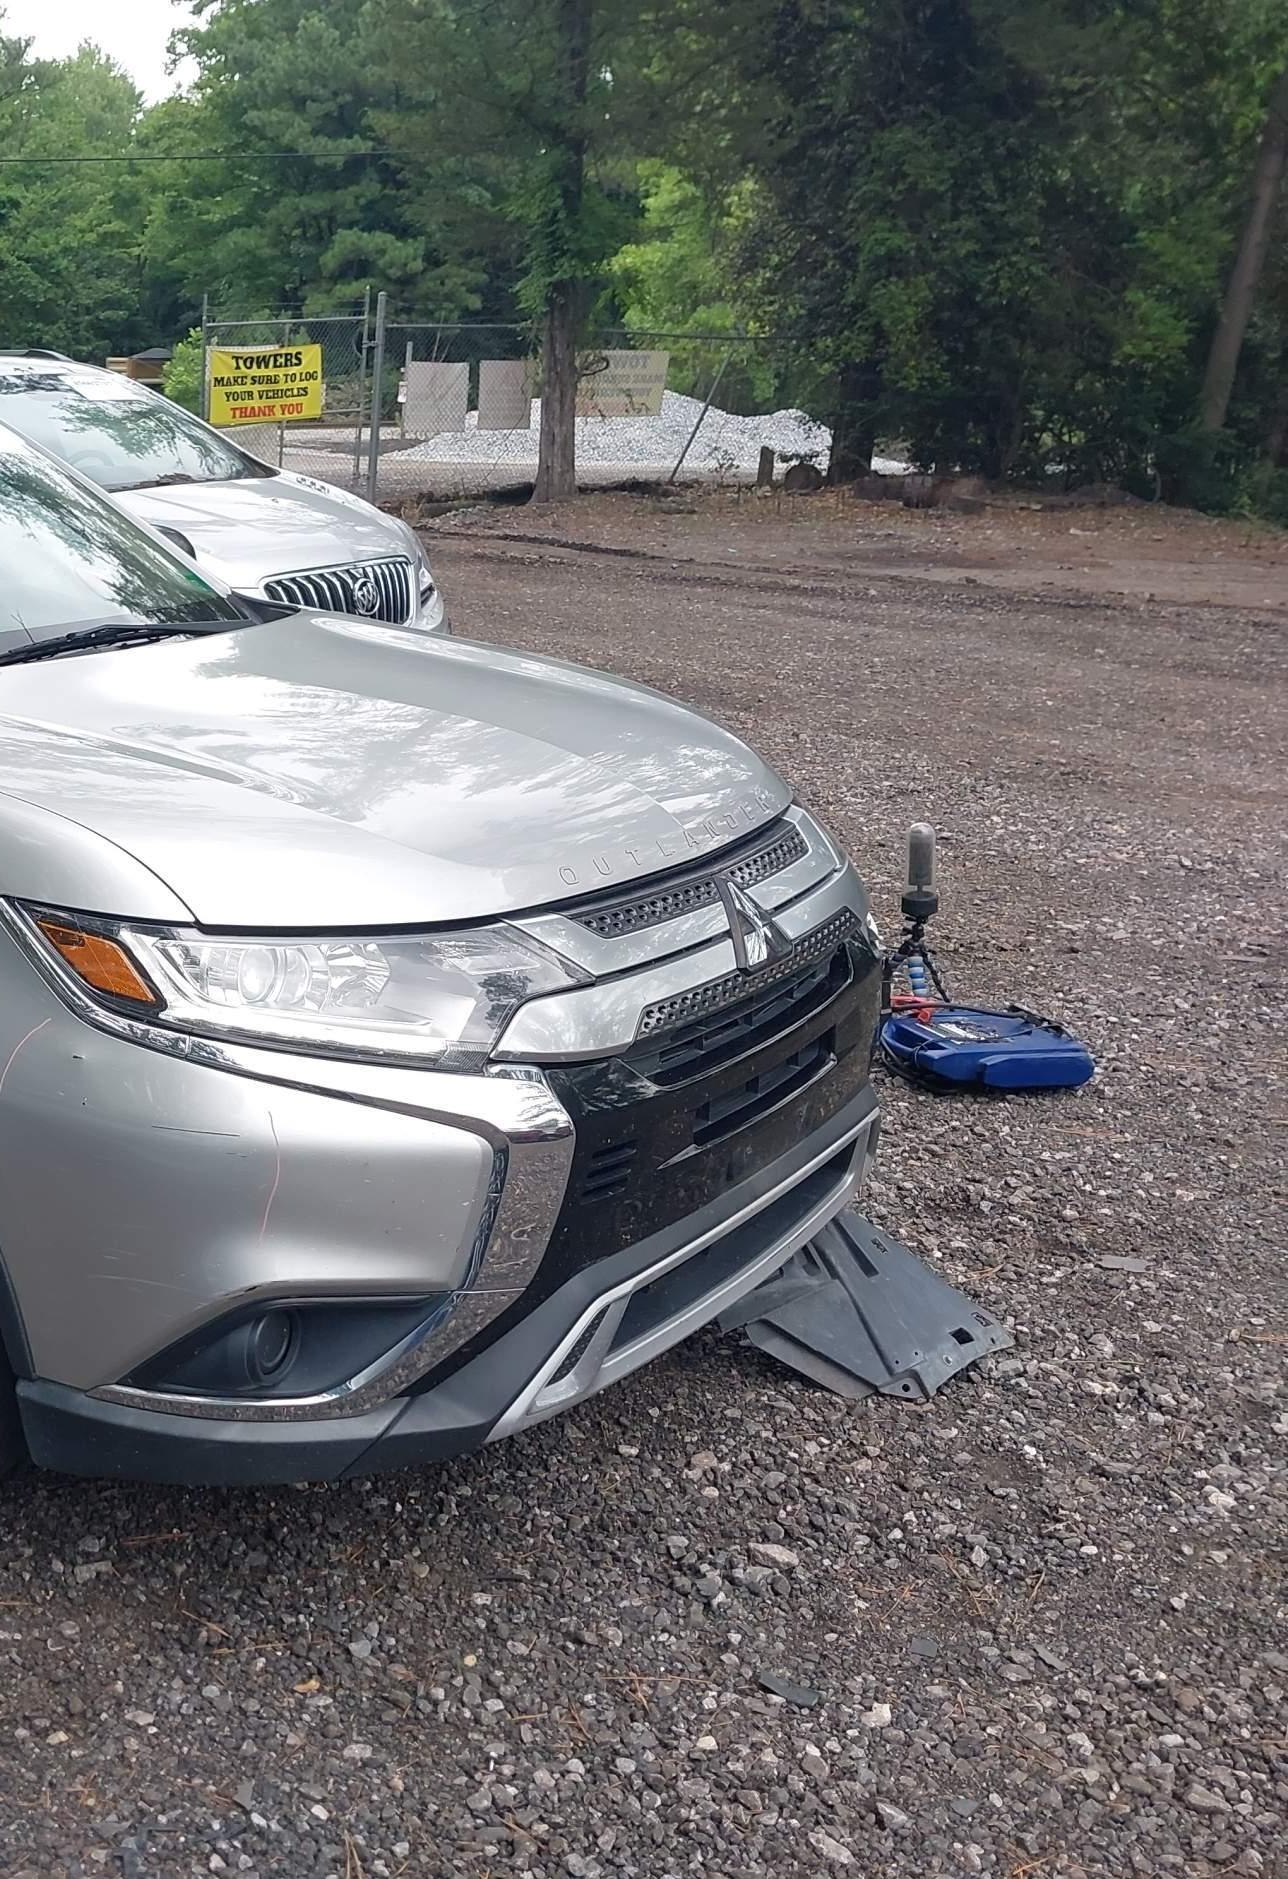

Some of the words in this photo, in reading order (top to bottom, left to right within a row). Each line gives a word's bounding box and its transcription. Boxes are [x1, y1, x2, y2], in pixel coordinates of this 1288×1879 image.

[232, 351, 303, 370] TOWERS
[213, 375, 248, 387] MAKE
[250, 374, 280, 386] SURE
[284, 372, 297, 384] TO
[299, 370, 318, 382] LOG
[224, 390, 255, 402] YOUR
[257, 387, 309, 400] VEHICLES
[230, 404, 276, 419] THANK
[279, 402, 304, 415] YOU
[558, 794, 775, 886] OUTLANDER
